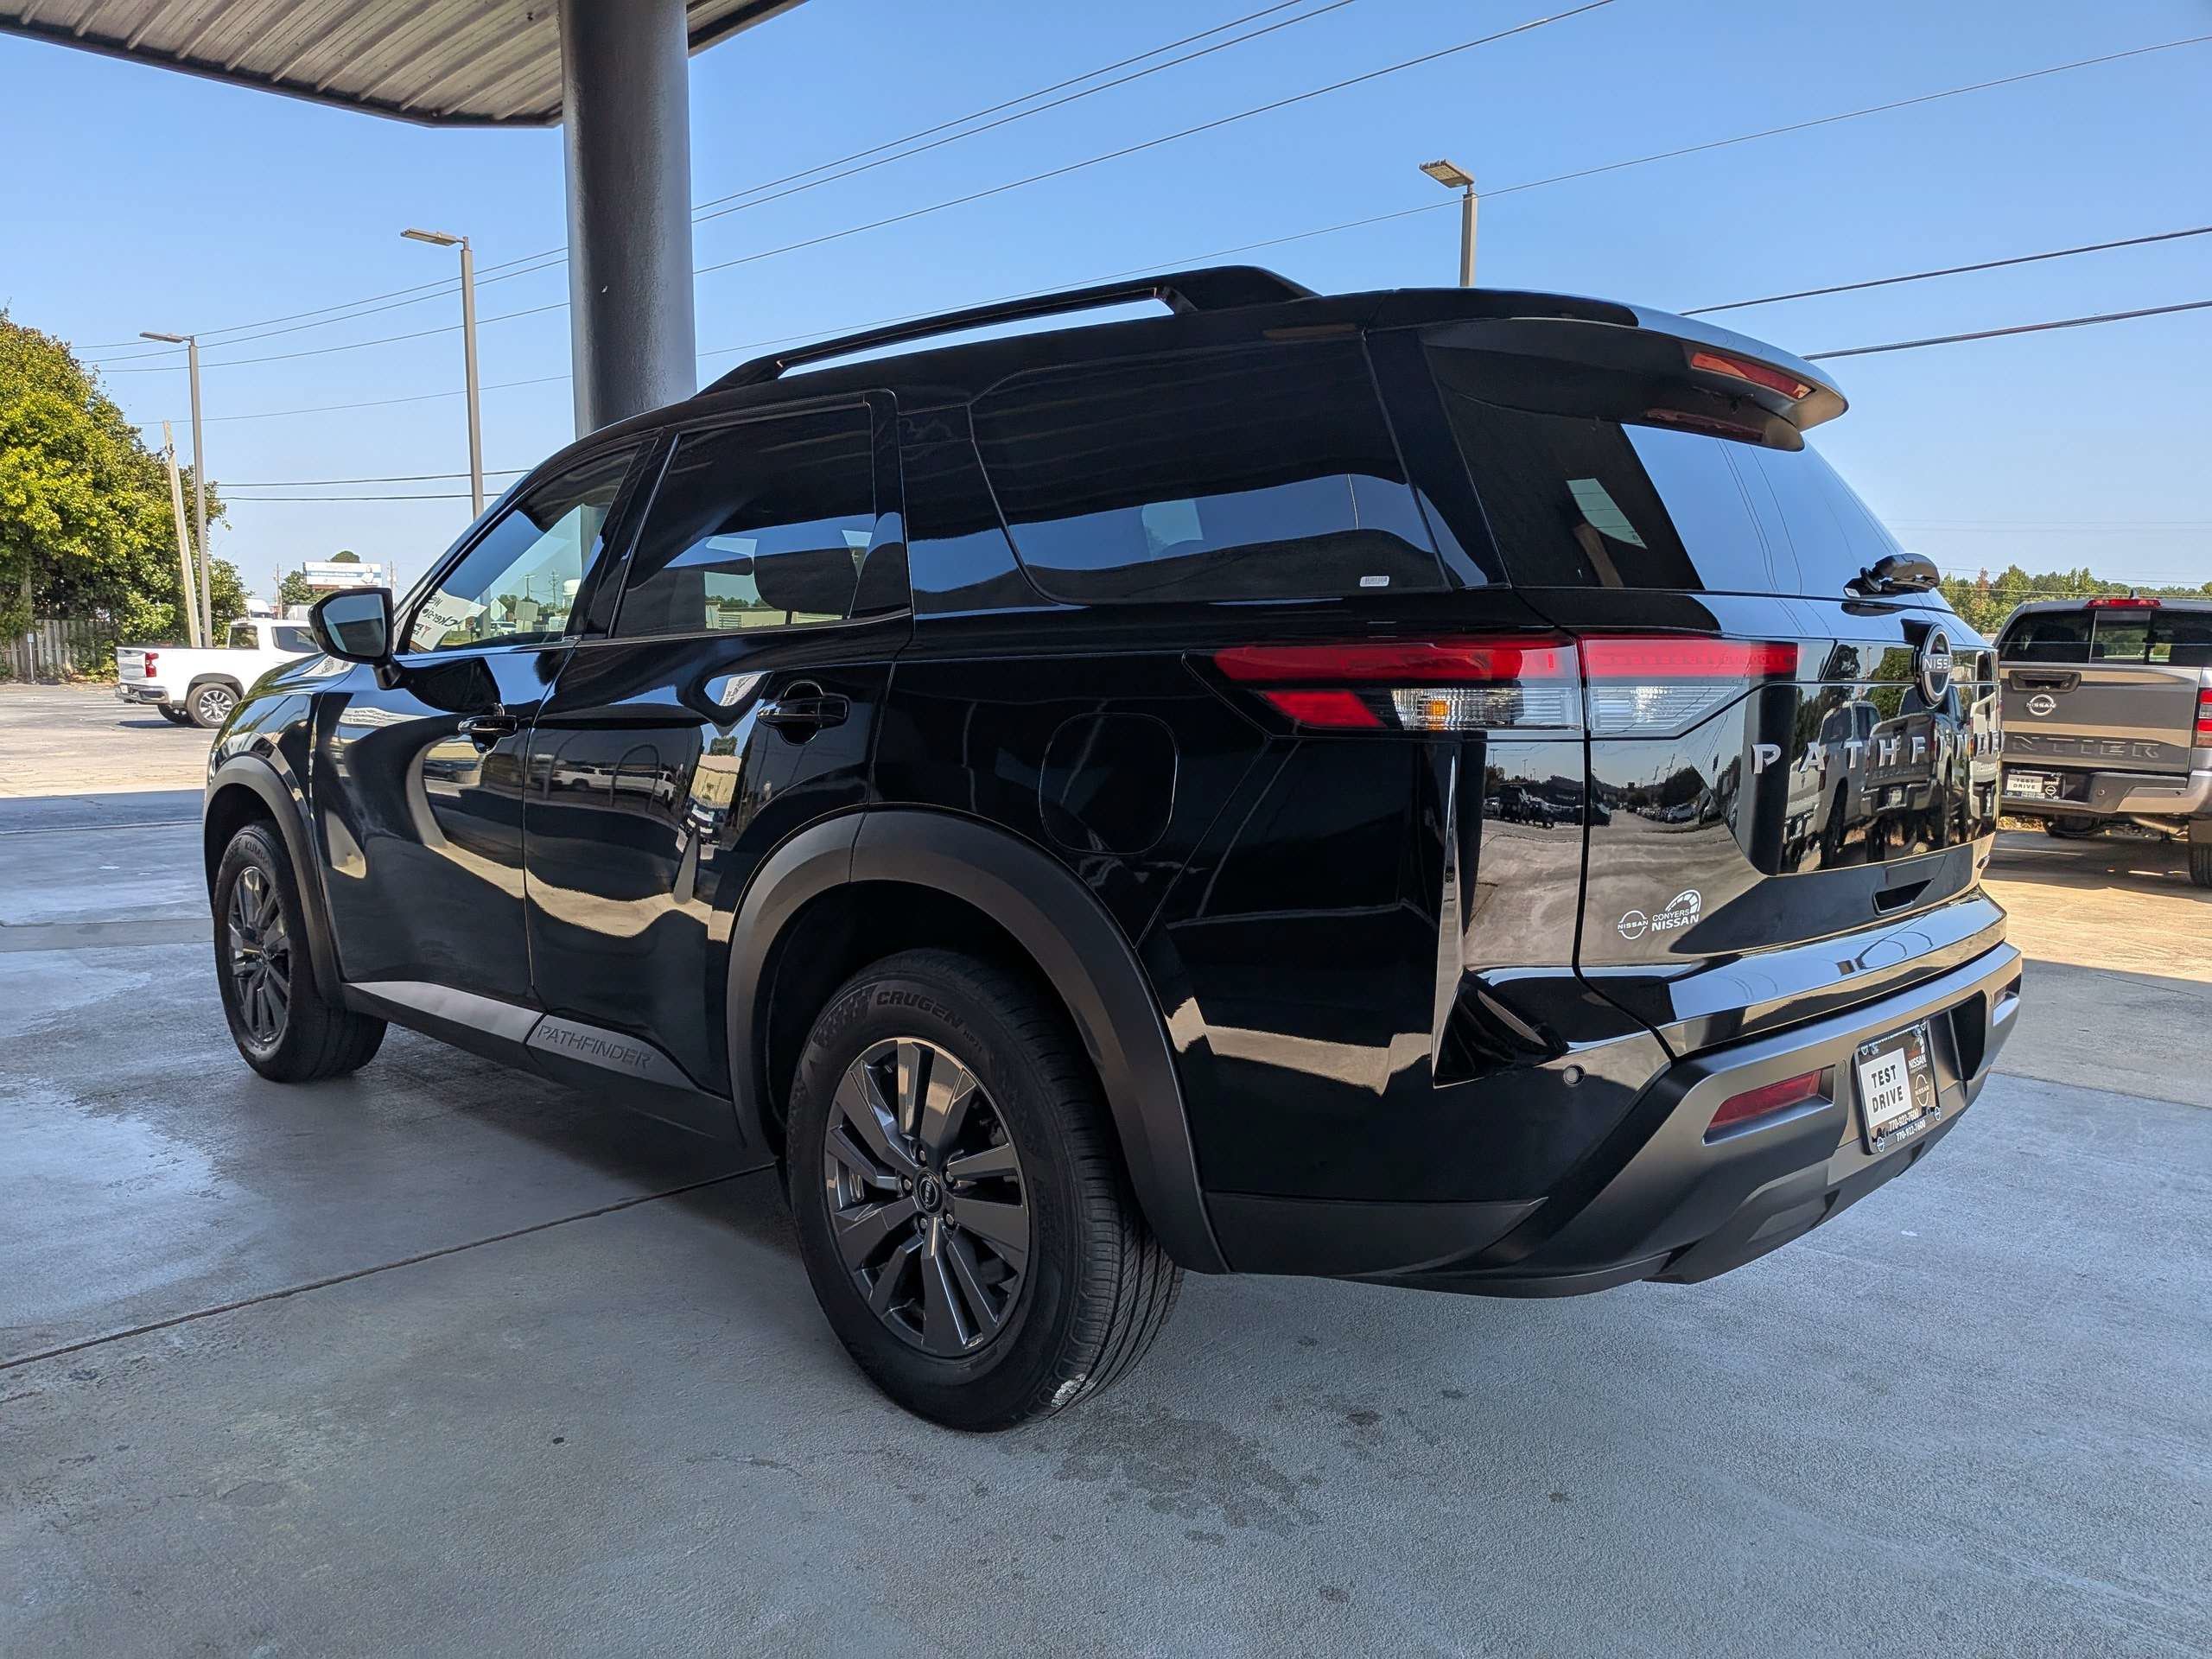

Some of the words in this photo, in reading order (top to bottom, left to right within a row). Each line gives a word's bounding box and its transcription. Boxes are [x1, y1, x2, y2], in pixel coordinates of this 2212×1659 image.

[1924, 658, 1951, 671] NISS
[1617, 919, 1649, 931] NISSAN
[1651, 914, 1700, 932] NISSAN
[1652, 908, 1690, 922] CONYERS
[876, 990, 963, 1029] CRUGEN
[537, 1024, 652, 1070] PATHFINDER
[1871, 1064, 1897, 1089] TEST
[1872, 1085, 1904, 1114] DRIVE
